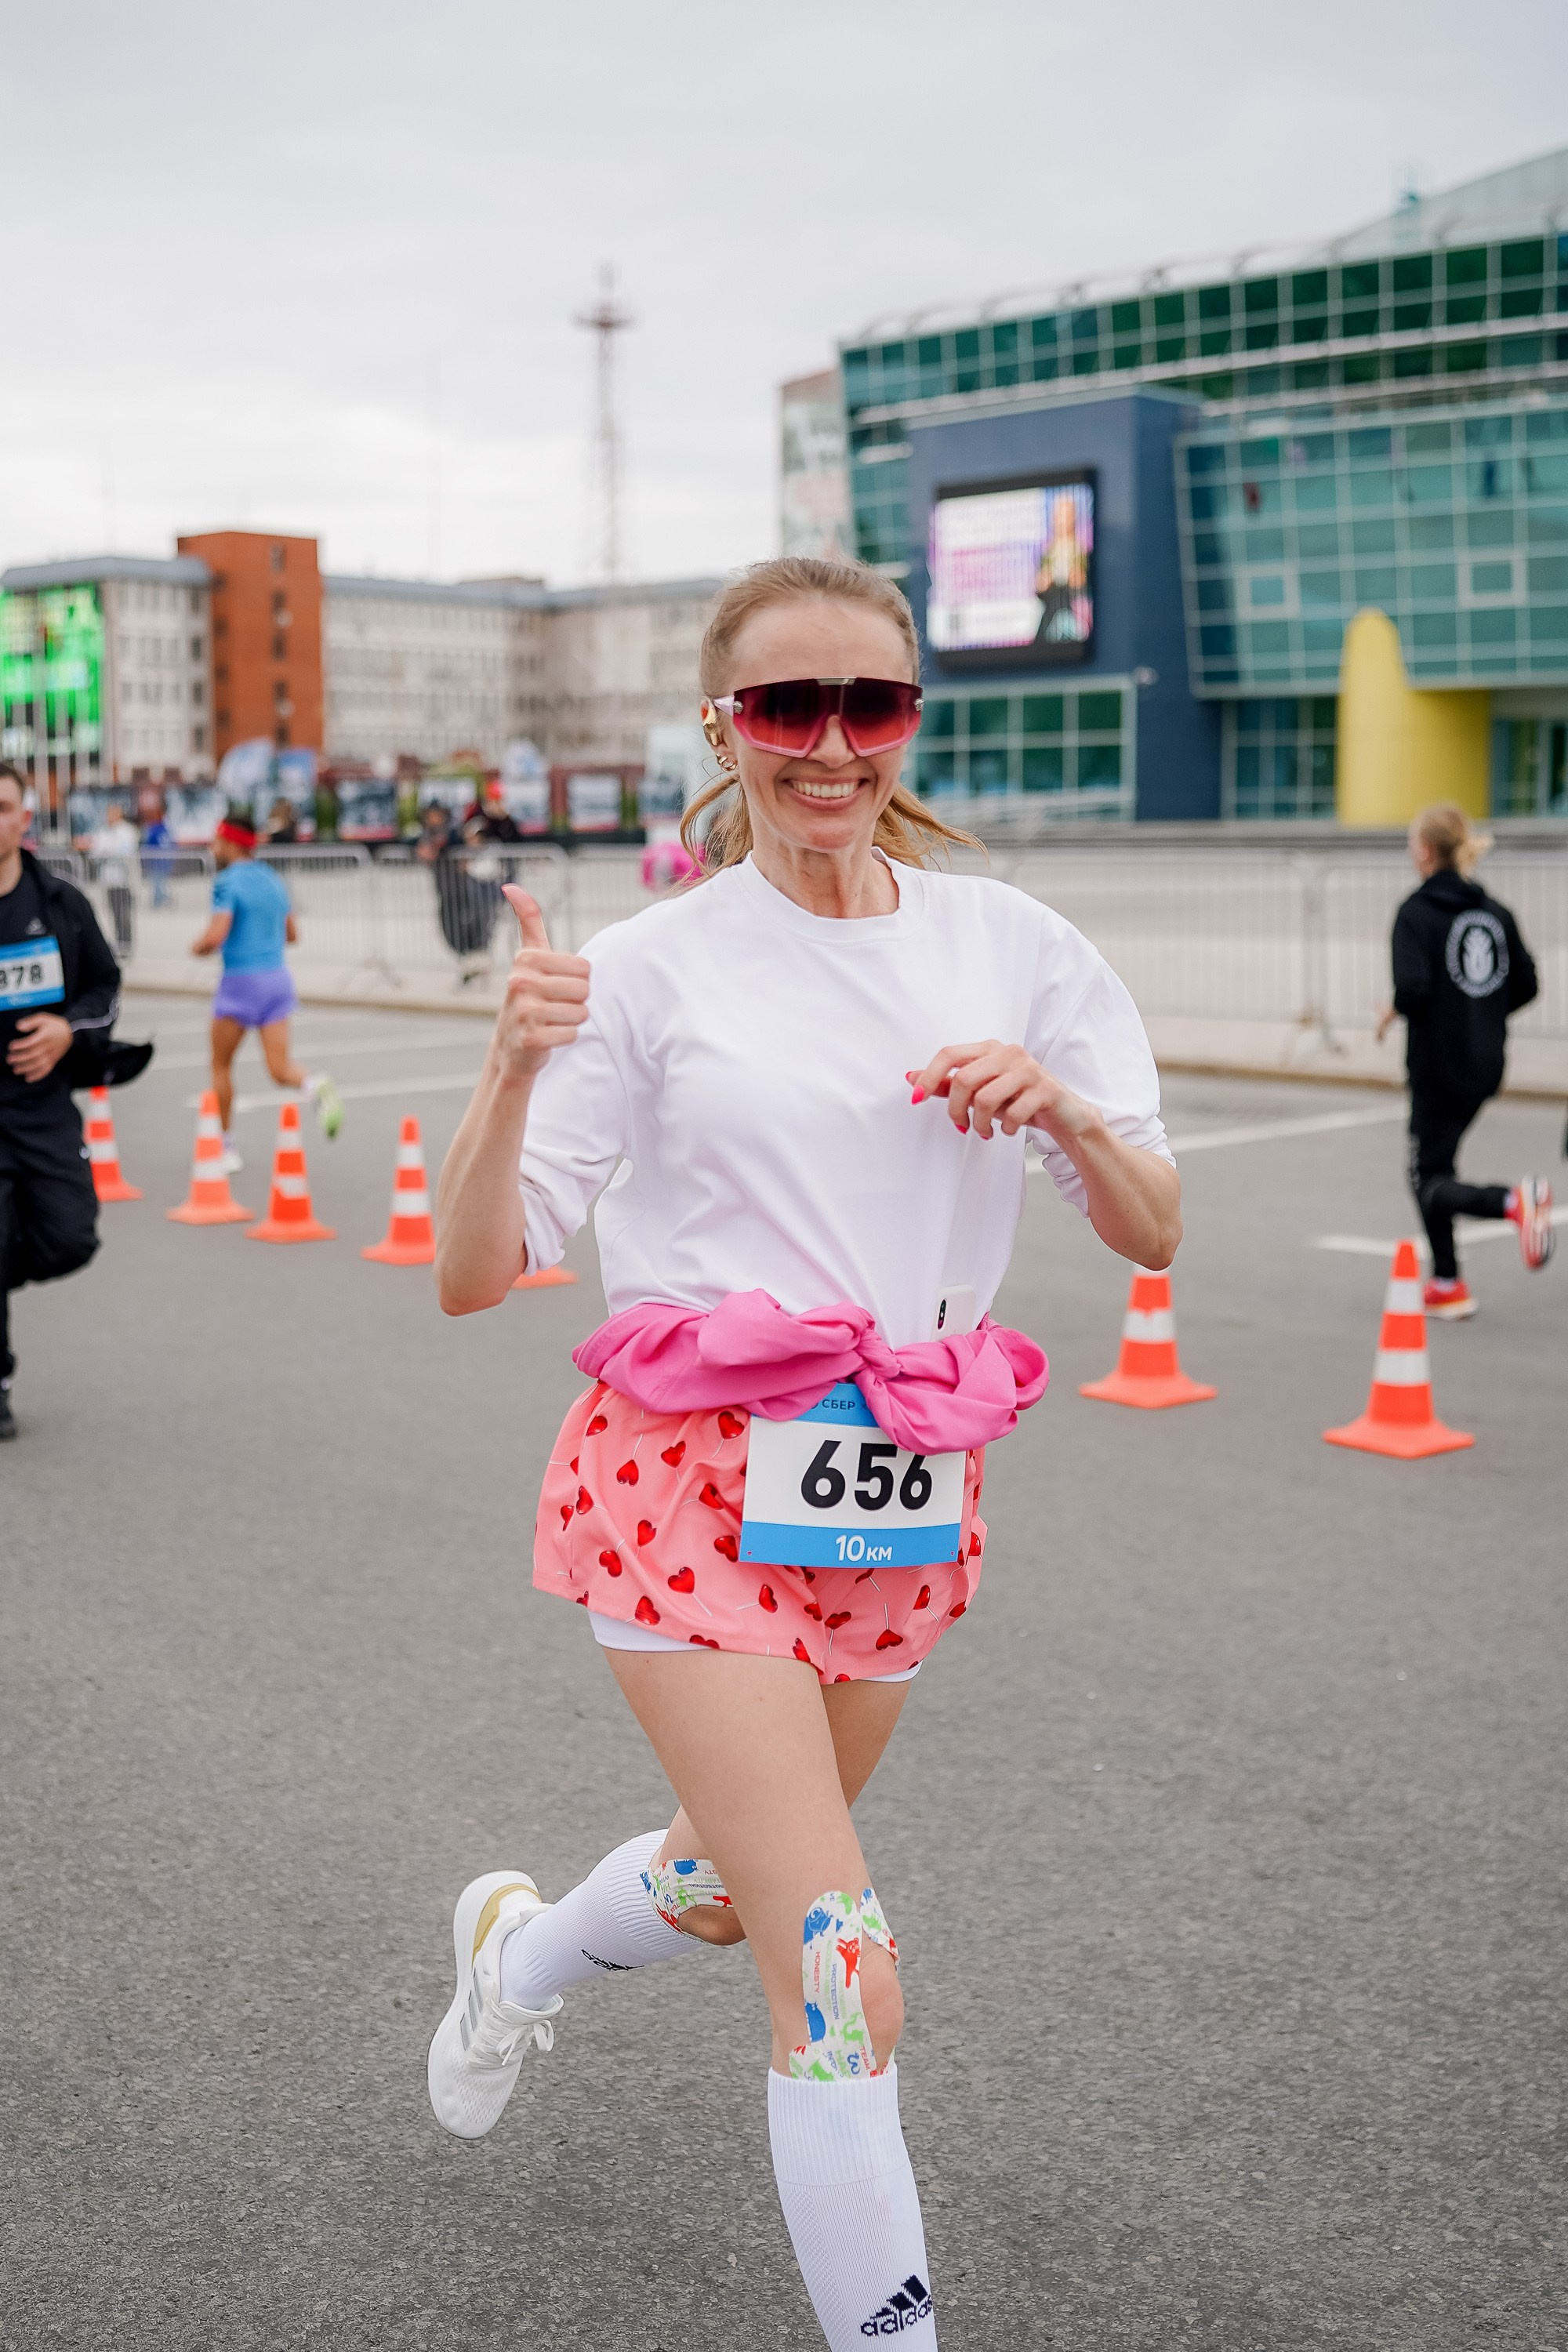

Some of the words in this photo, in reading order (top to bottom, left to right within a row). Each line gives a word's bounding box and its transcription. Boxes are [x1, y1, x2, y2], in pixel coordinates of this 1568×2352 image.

[822, 1399, 855, 1410] СБЕР
[800, 1439, 932, 1511] 656
[830, 1963, 840, 2020] PROTECTION
[860, 2045, 871, 2071] TEAM
[860, 2295, 933, 2336] adidas
